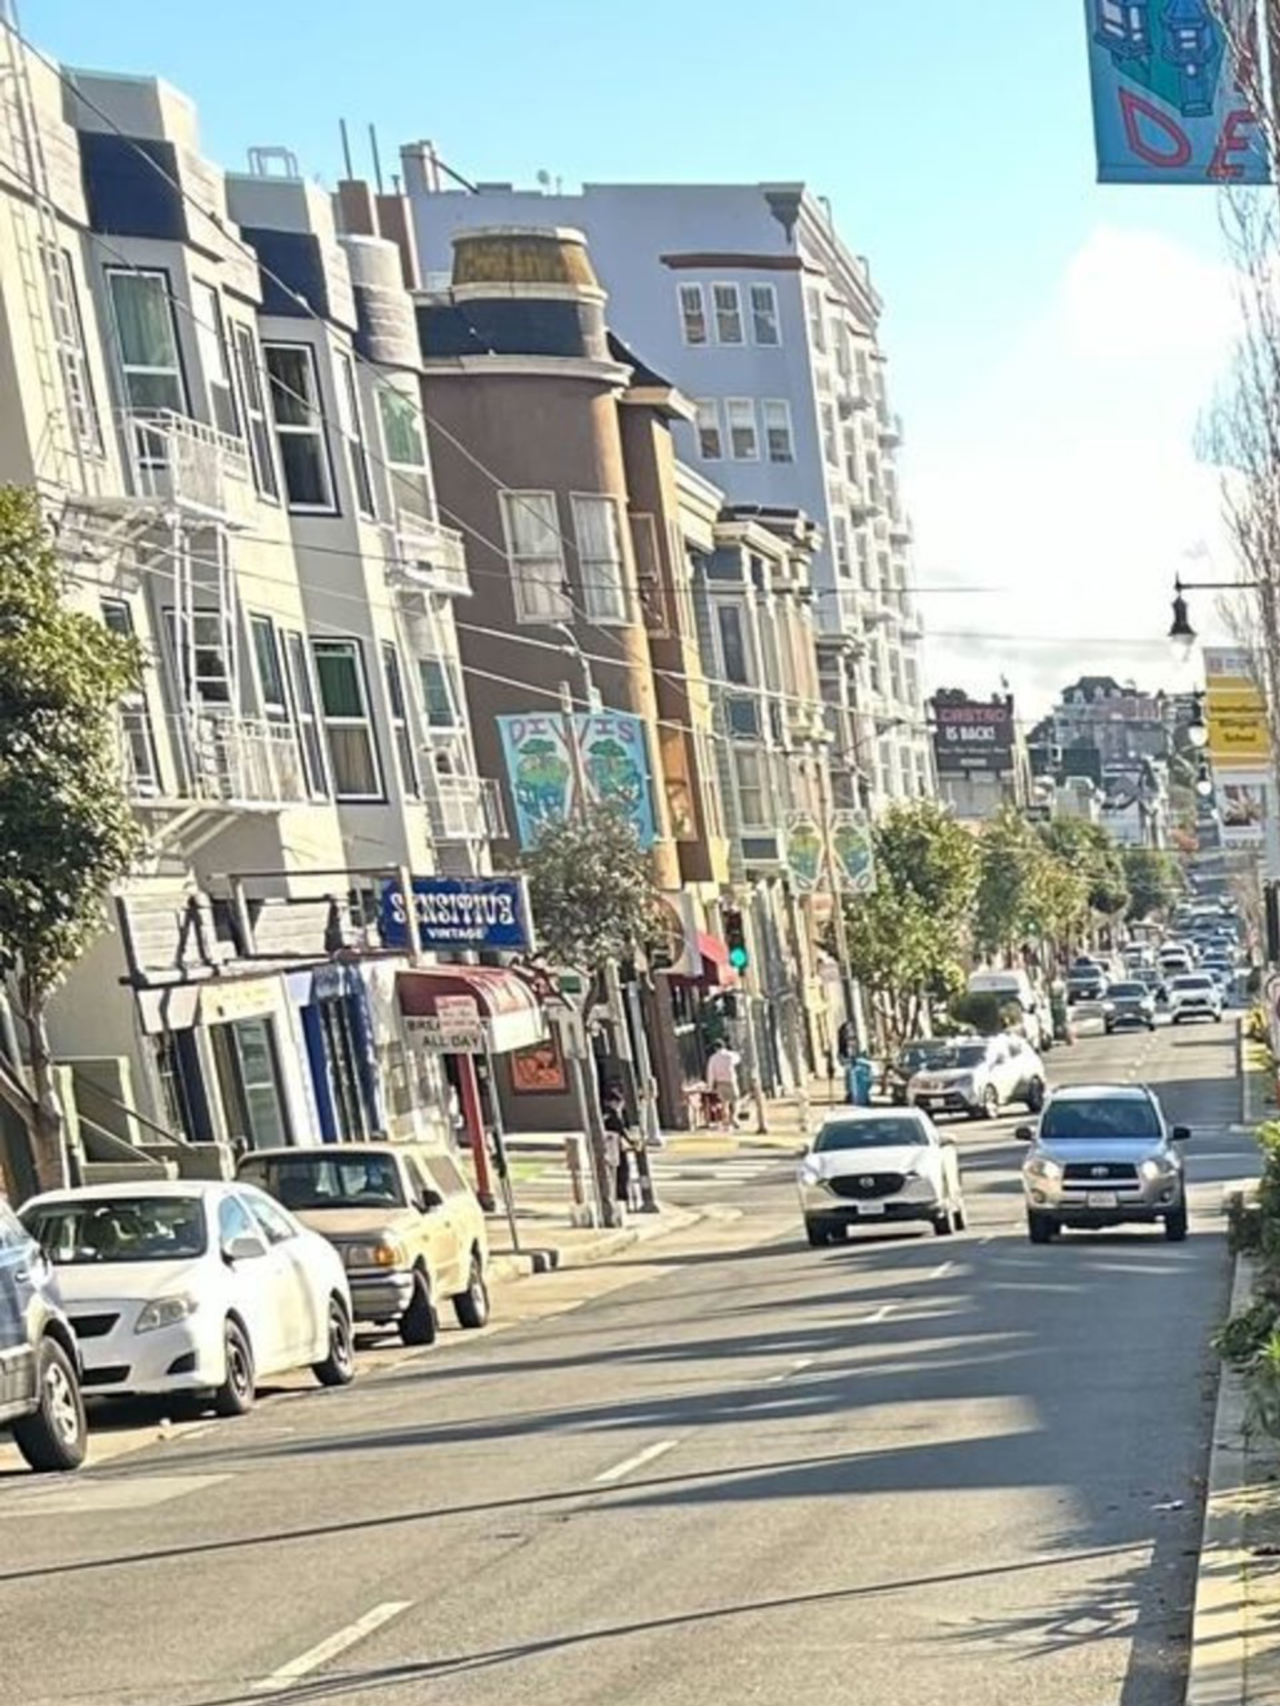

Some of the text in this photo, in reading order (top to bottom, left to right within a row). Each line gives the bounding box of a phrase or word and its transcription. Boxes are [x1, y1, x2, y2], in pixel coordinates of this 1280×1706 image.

[427, 928, 485, 939] VINTAGE
[422, 1035, 478, 1047] ALL DAY
